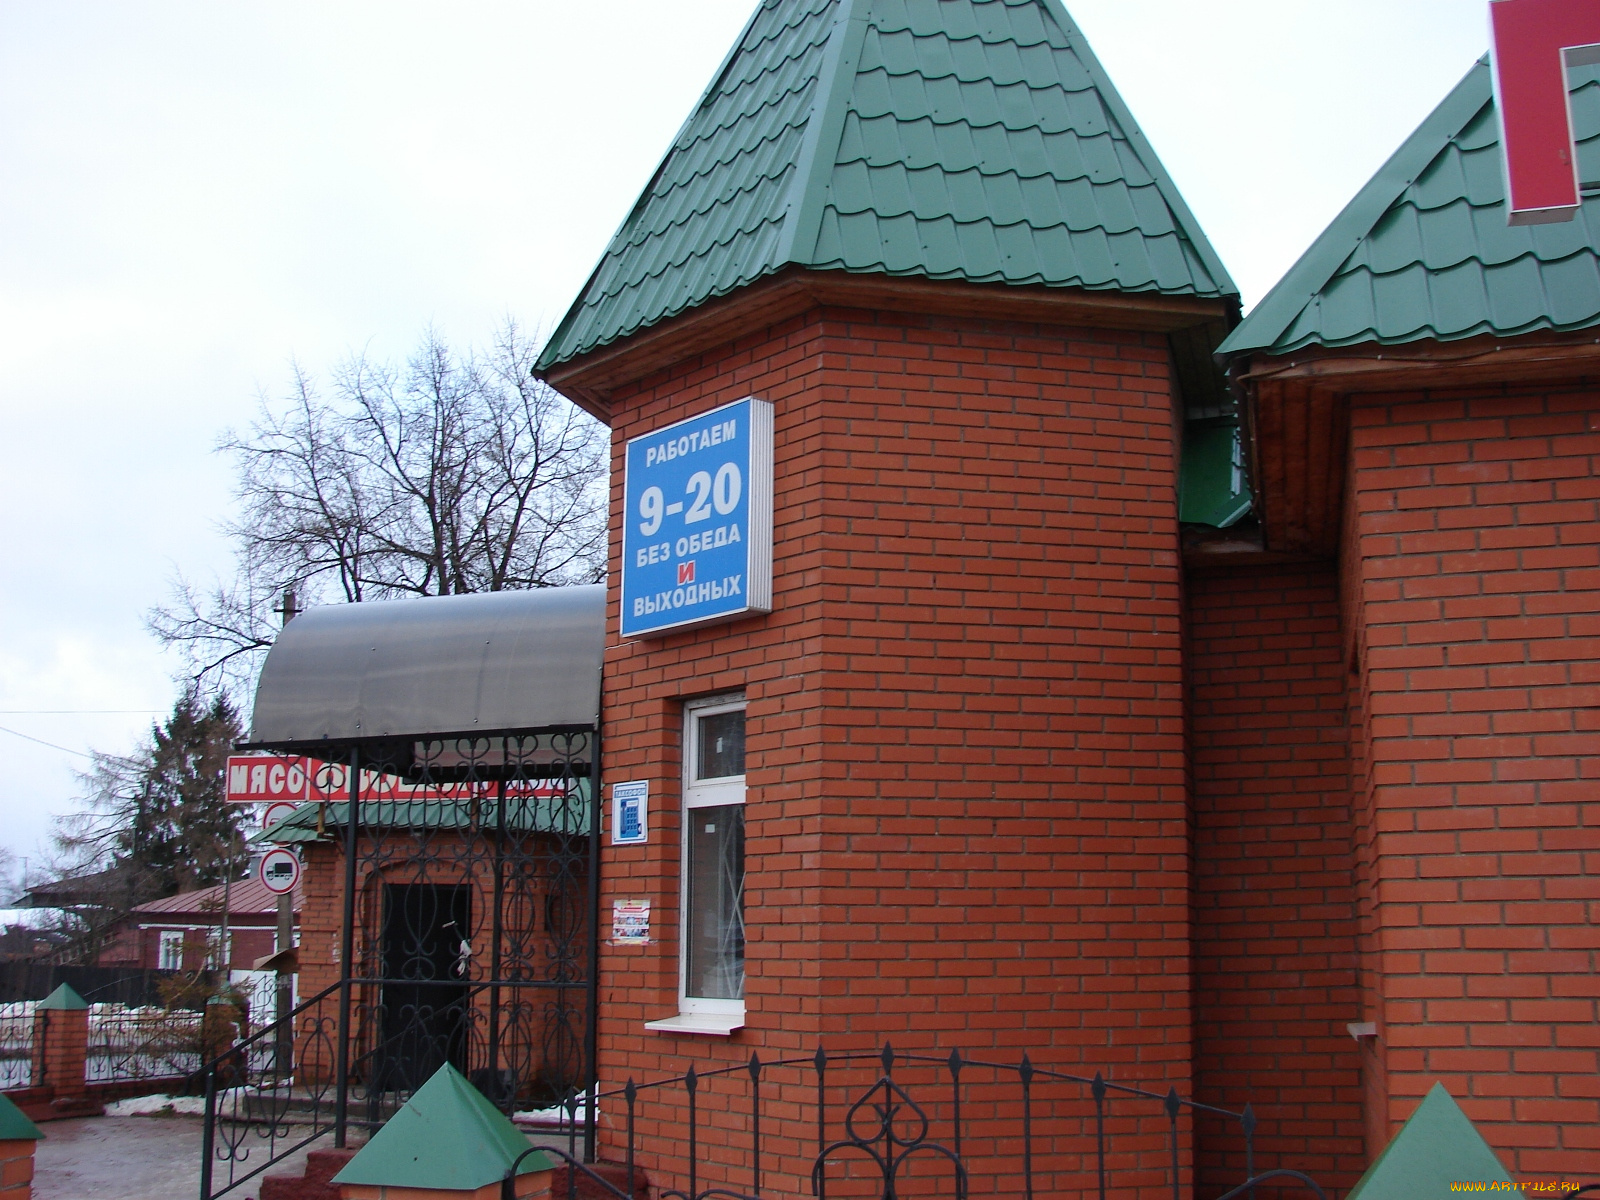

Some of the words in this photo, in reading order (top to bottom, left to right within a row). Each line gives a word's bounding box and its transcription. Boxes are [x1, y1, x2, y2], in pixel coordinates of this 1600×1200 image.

[646, 419, 736, 467] РАБОТАЕМ
[639, 462, 742, 537] 9-20
[636, 542, 670, 568] БЕЗ
[675, 523, 741, 557] ОБЕДА
[677, 560, 696, 586] И
[633, 574, 741, 617] ВЫХОДНЫХ
[229, 764, 303, 795] МЯСО
